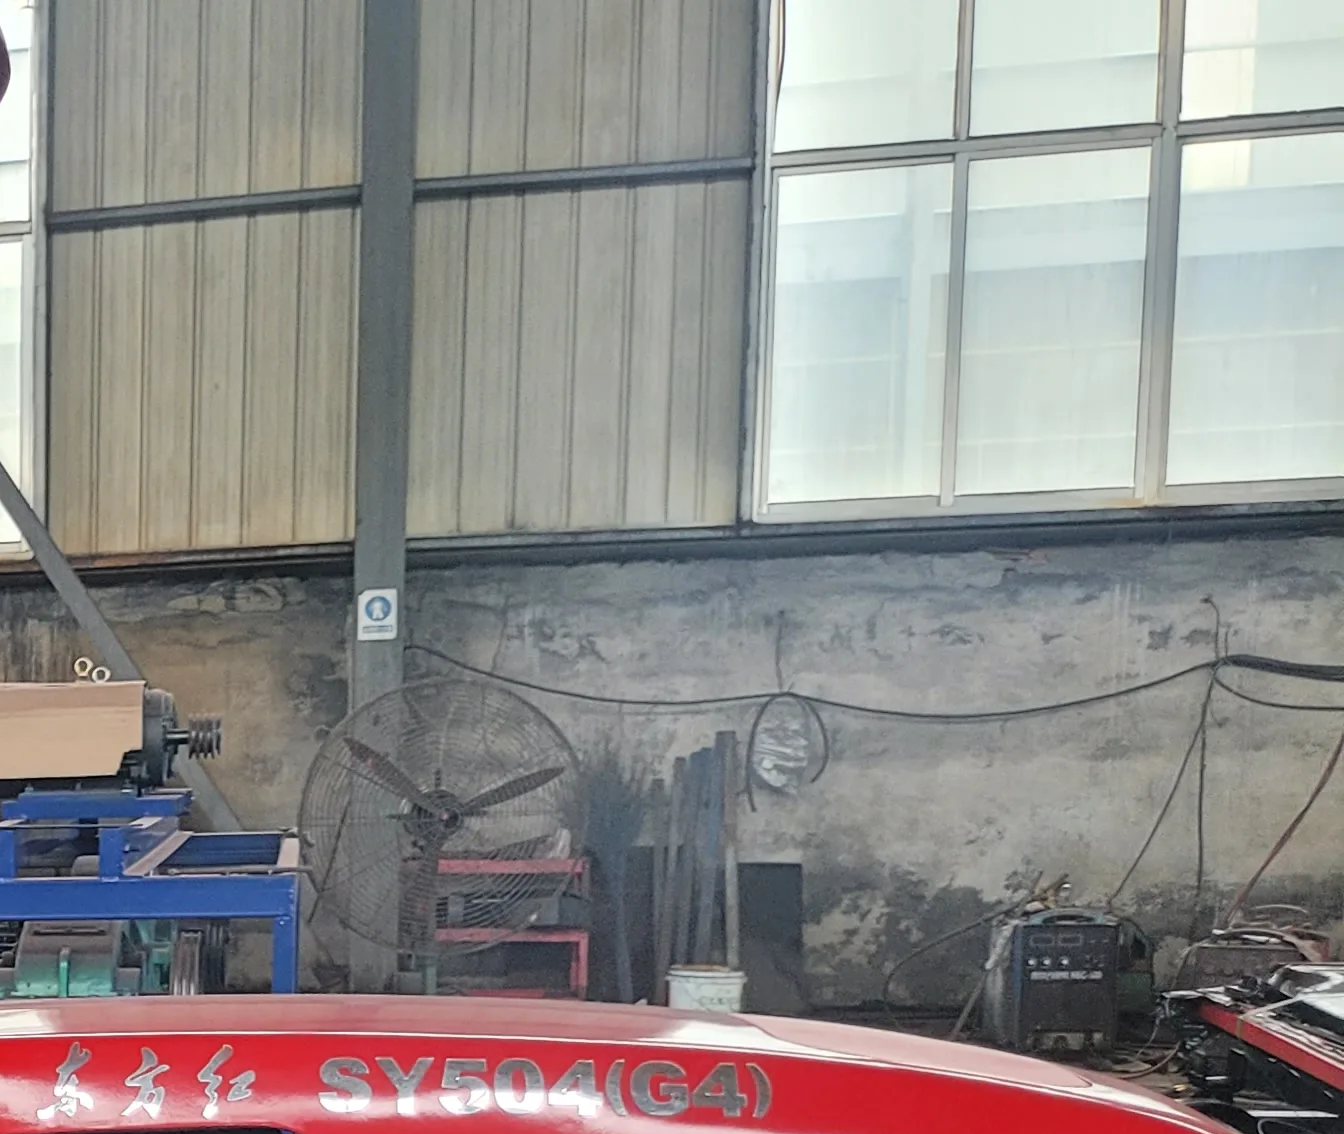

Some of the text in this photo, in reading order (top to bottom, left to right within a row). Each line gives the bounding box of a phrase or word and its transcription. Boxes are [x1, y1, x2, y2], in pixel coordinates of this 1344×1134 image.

[37, 1042, 256, 1120] 东方红
[318, 1056, 772, 1119] SY504(G4)
